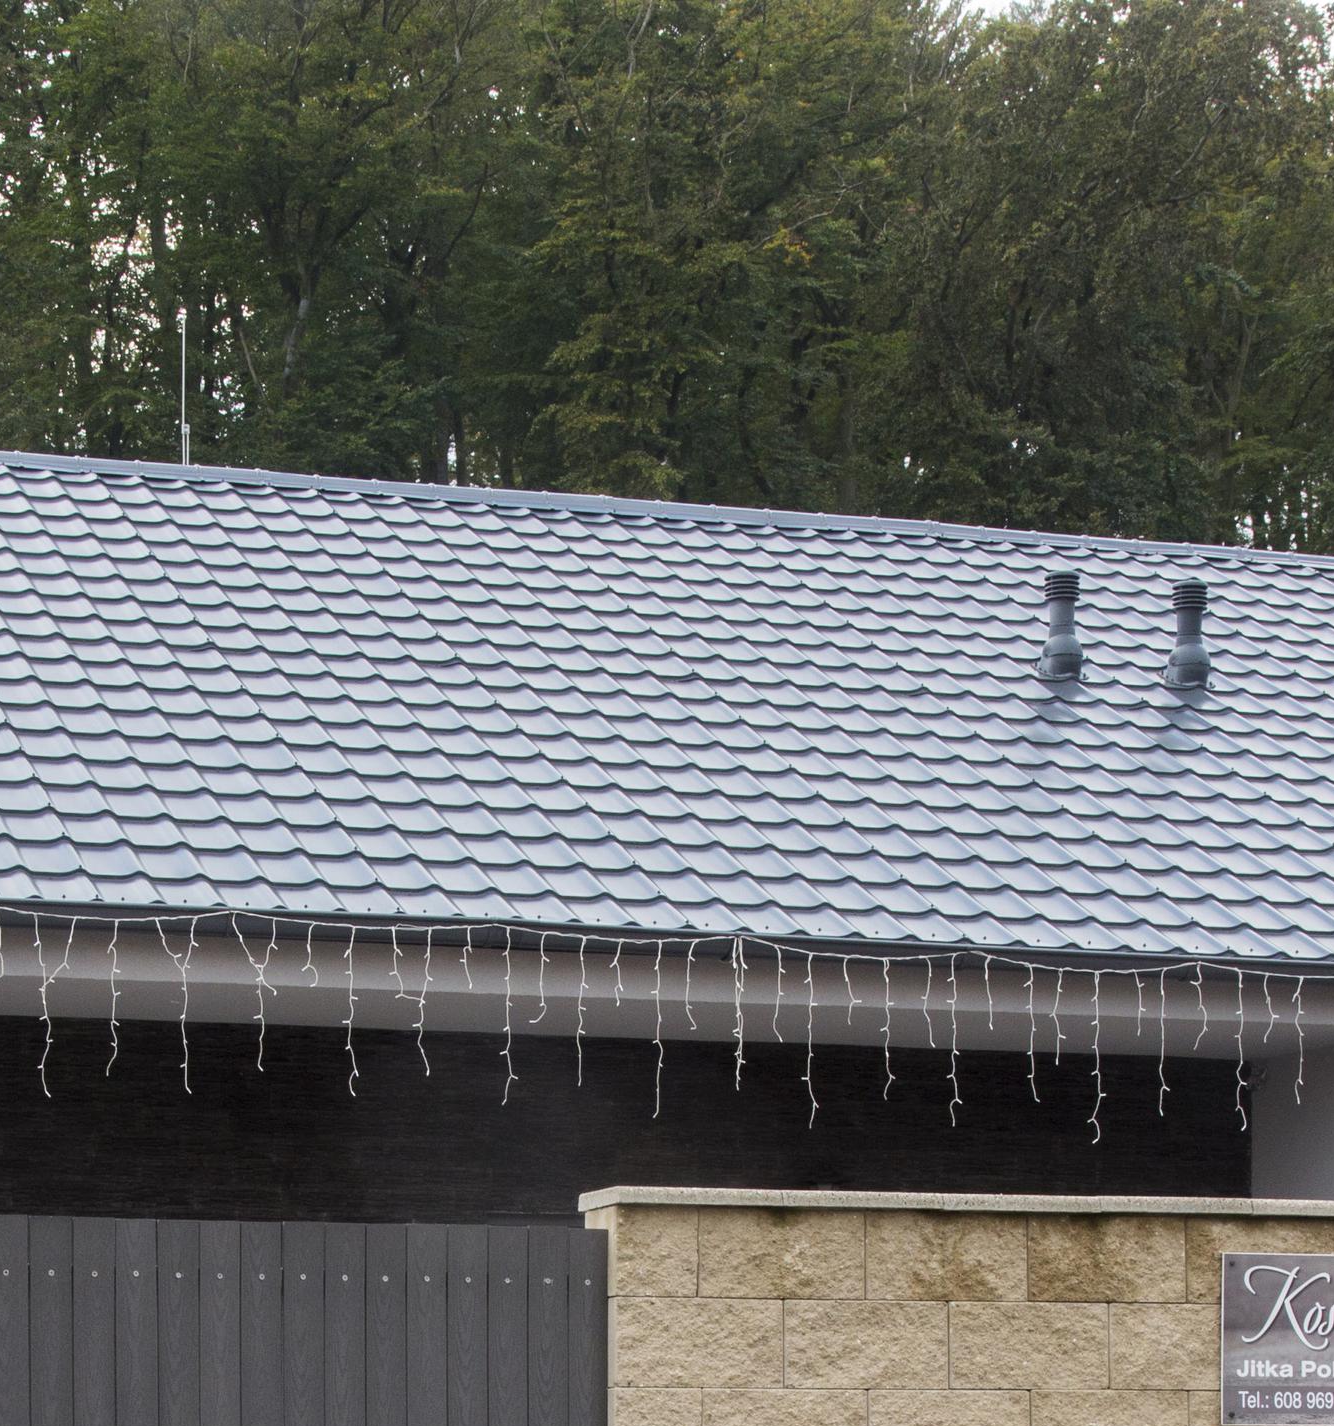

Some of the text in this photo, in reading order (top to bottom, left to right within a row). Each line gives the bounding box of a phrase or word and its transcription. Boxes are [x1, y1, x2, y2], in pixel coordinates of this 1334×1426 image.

[1236, 1358, 1294, 1378] Jitka
[1238, 1390, 1269, 1409] Tel.:
[1274, 1391, 1302, 1409] 608
[1306, 1391, 1334, 1409] 969
